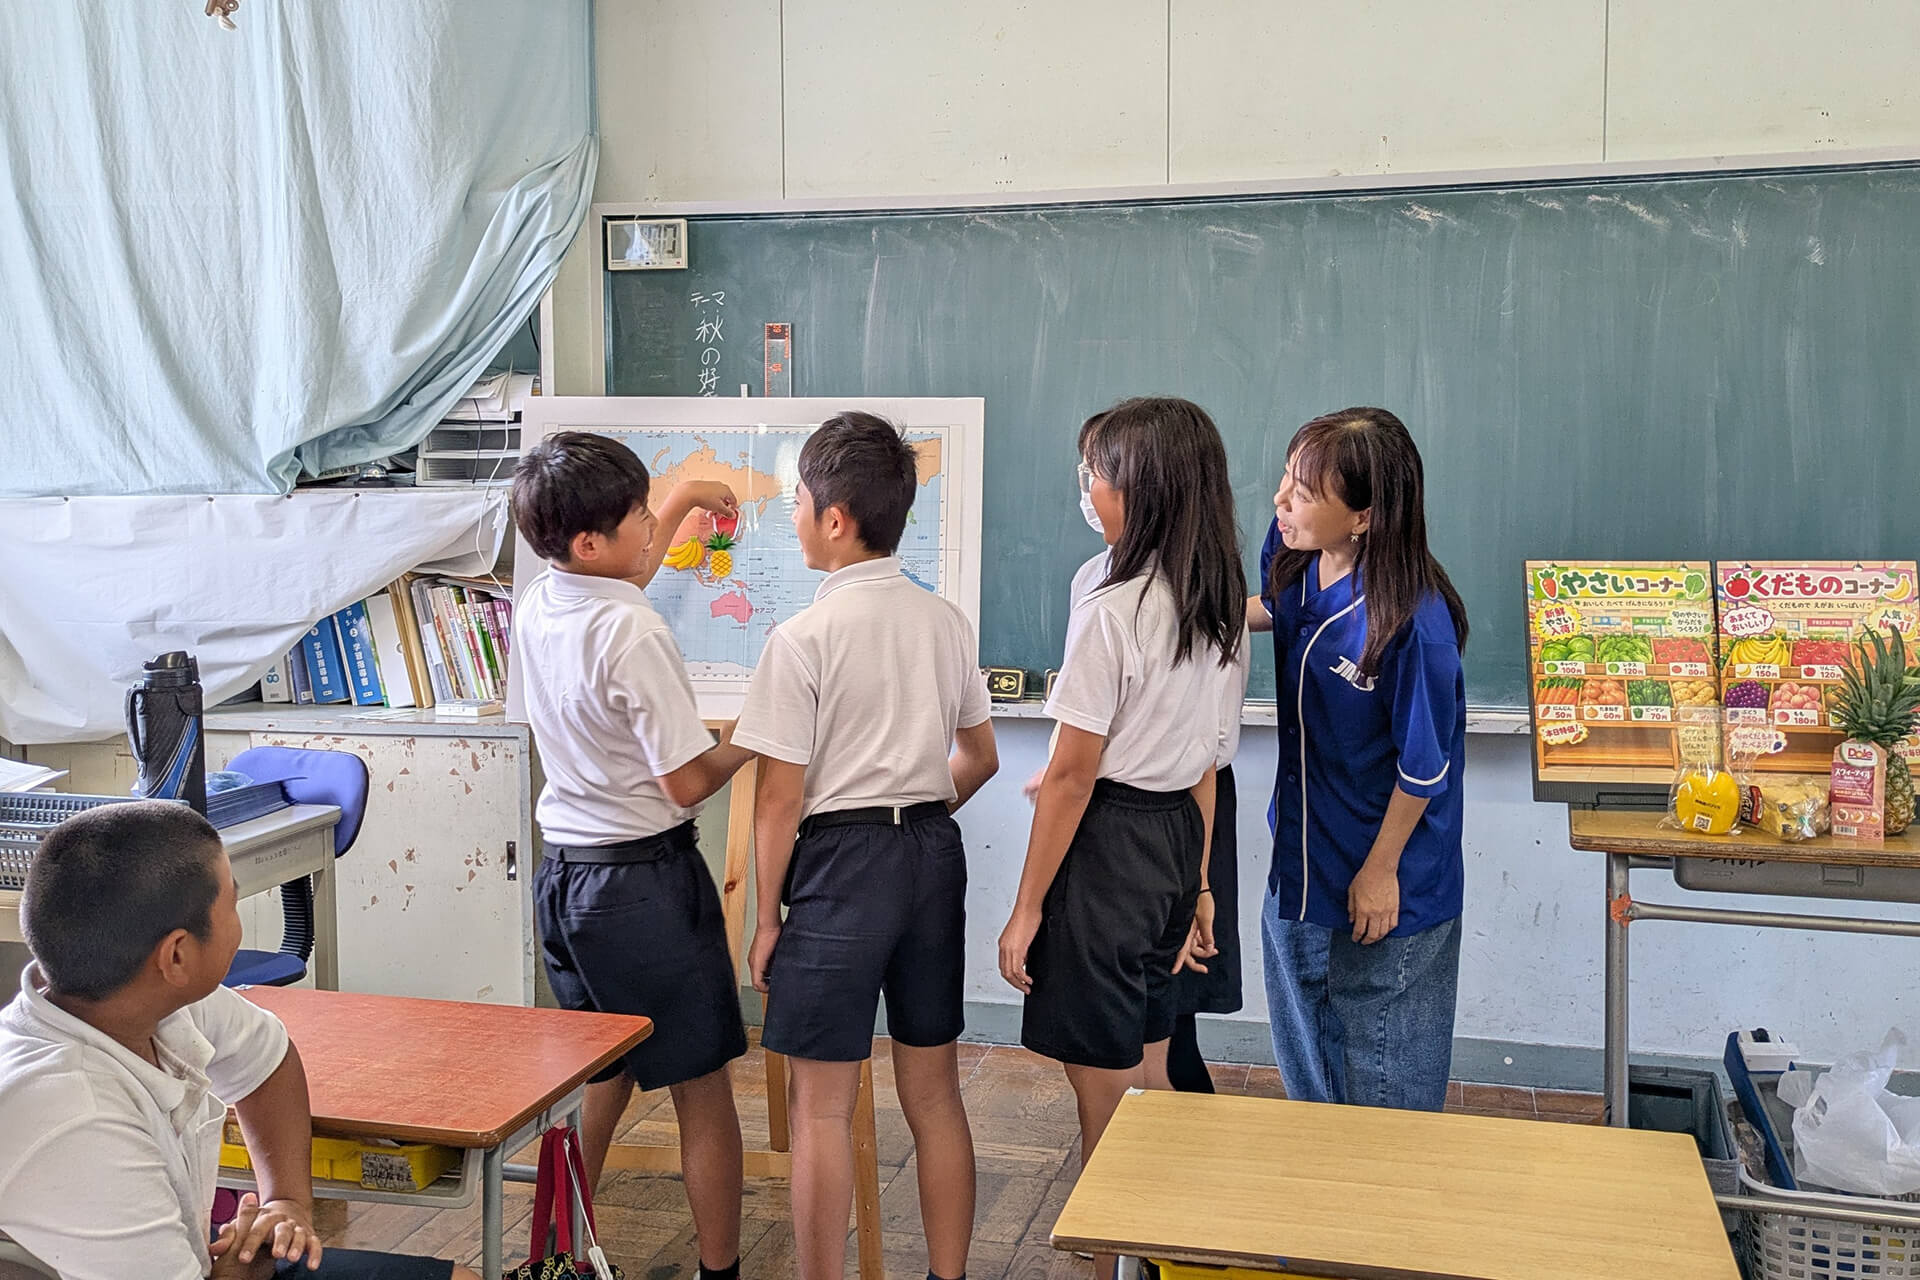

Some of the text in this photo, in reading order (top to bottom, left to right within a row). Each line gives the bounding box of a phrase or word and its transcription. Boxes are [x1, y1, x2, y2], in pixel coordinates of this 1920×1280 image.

[690, 291, 725, 308] テーマ
[1561, 571, 1684, 595] やさいコーナー
[1752, 572, 1895, 596] くだものコーナー
[1545, 607, 1566, 619] 新鮮
[1729, 611, 1757, 624] あまくて
[1880, 609, 1902, 620] 人気
[1546, 615, 1573, 626] やさい
[1848, 748, 1873, 758] Dole
